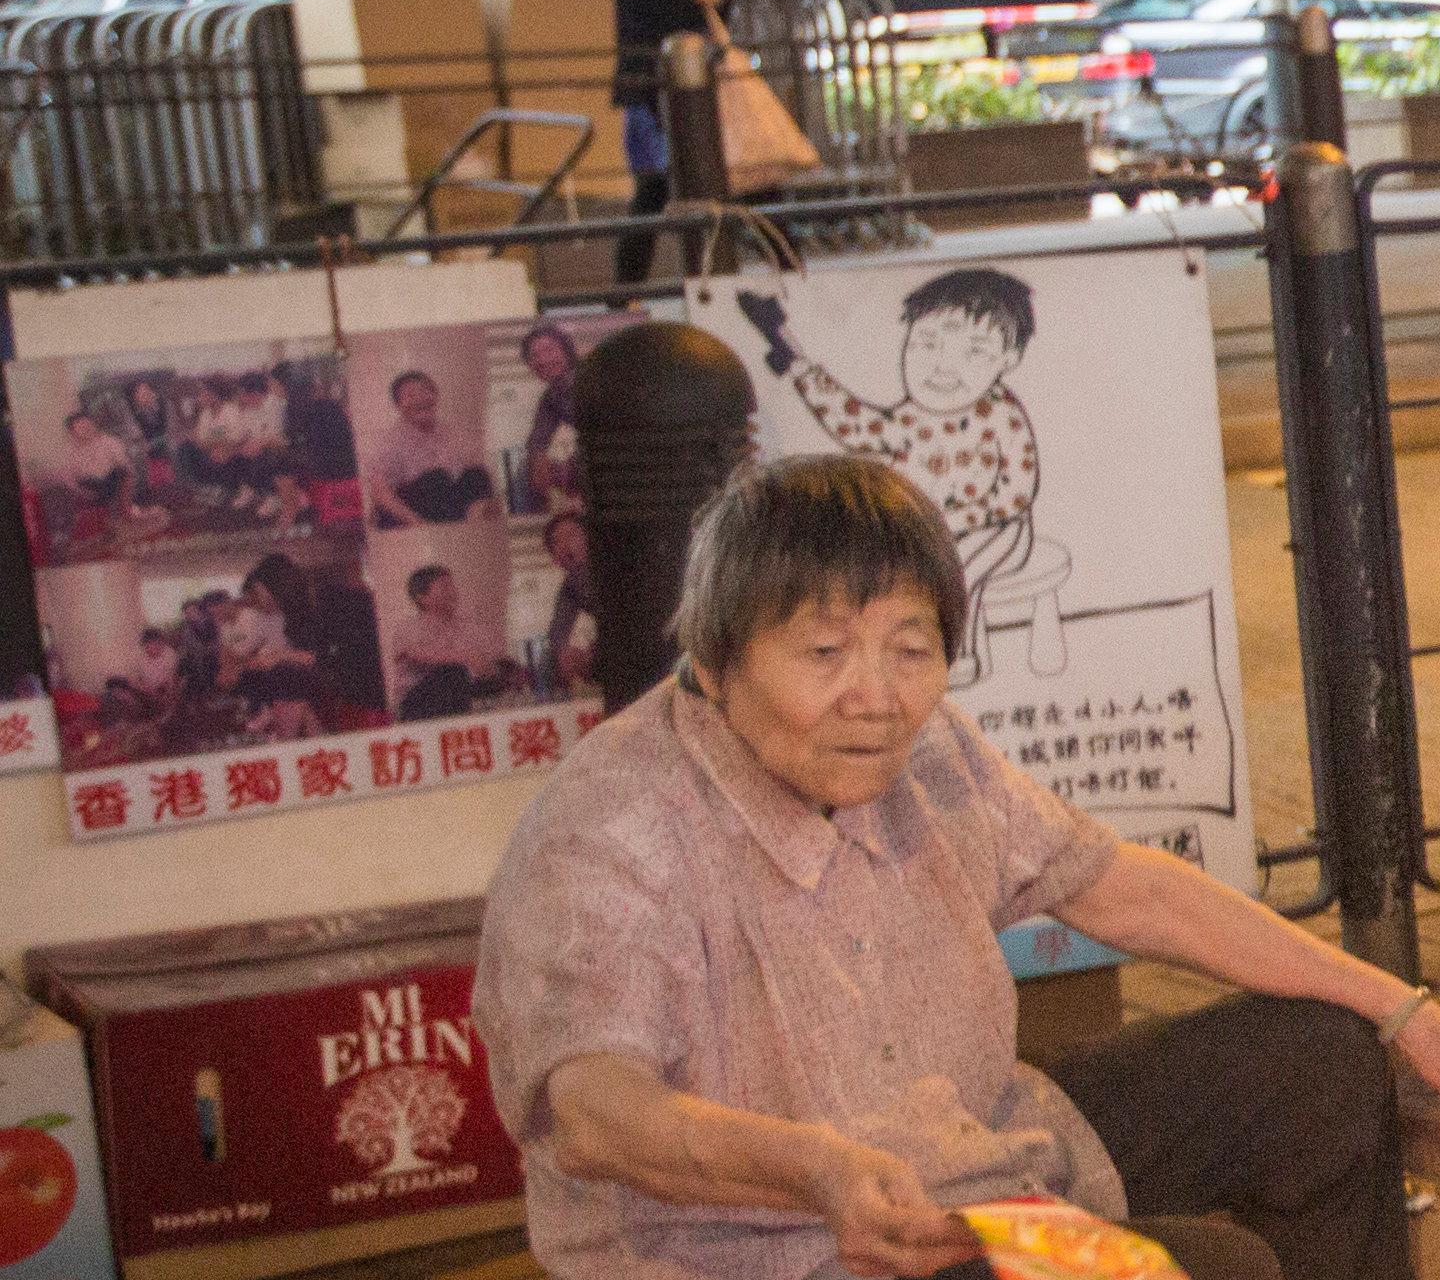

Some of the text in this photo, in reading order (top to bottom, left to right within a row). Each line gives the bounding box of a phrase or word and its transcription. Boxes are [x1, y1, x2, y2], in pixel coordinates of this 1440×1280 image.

[361, 981, 421, 1025] MI
[320, 1020, 473, 1086] ERIN
[332, 1165, 478, 1207] NEW ZEALAND
